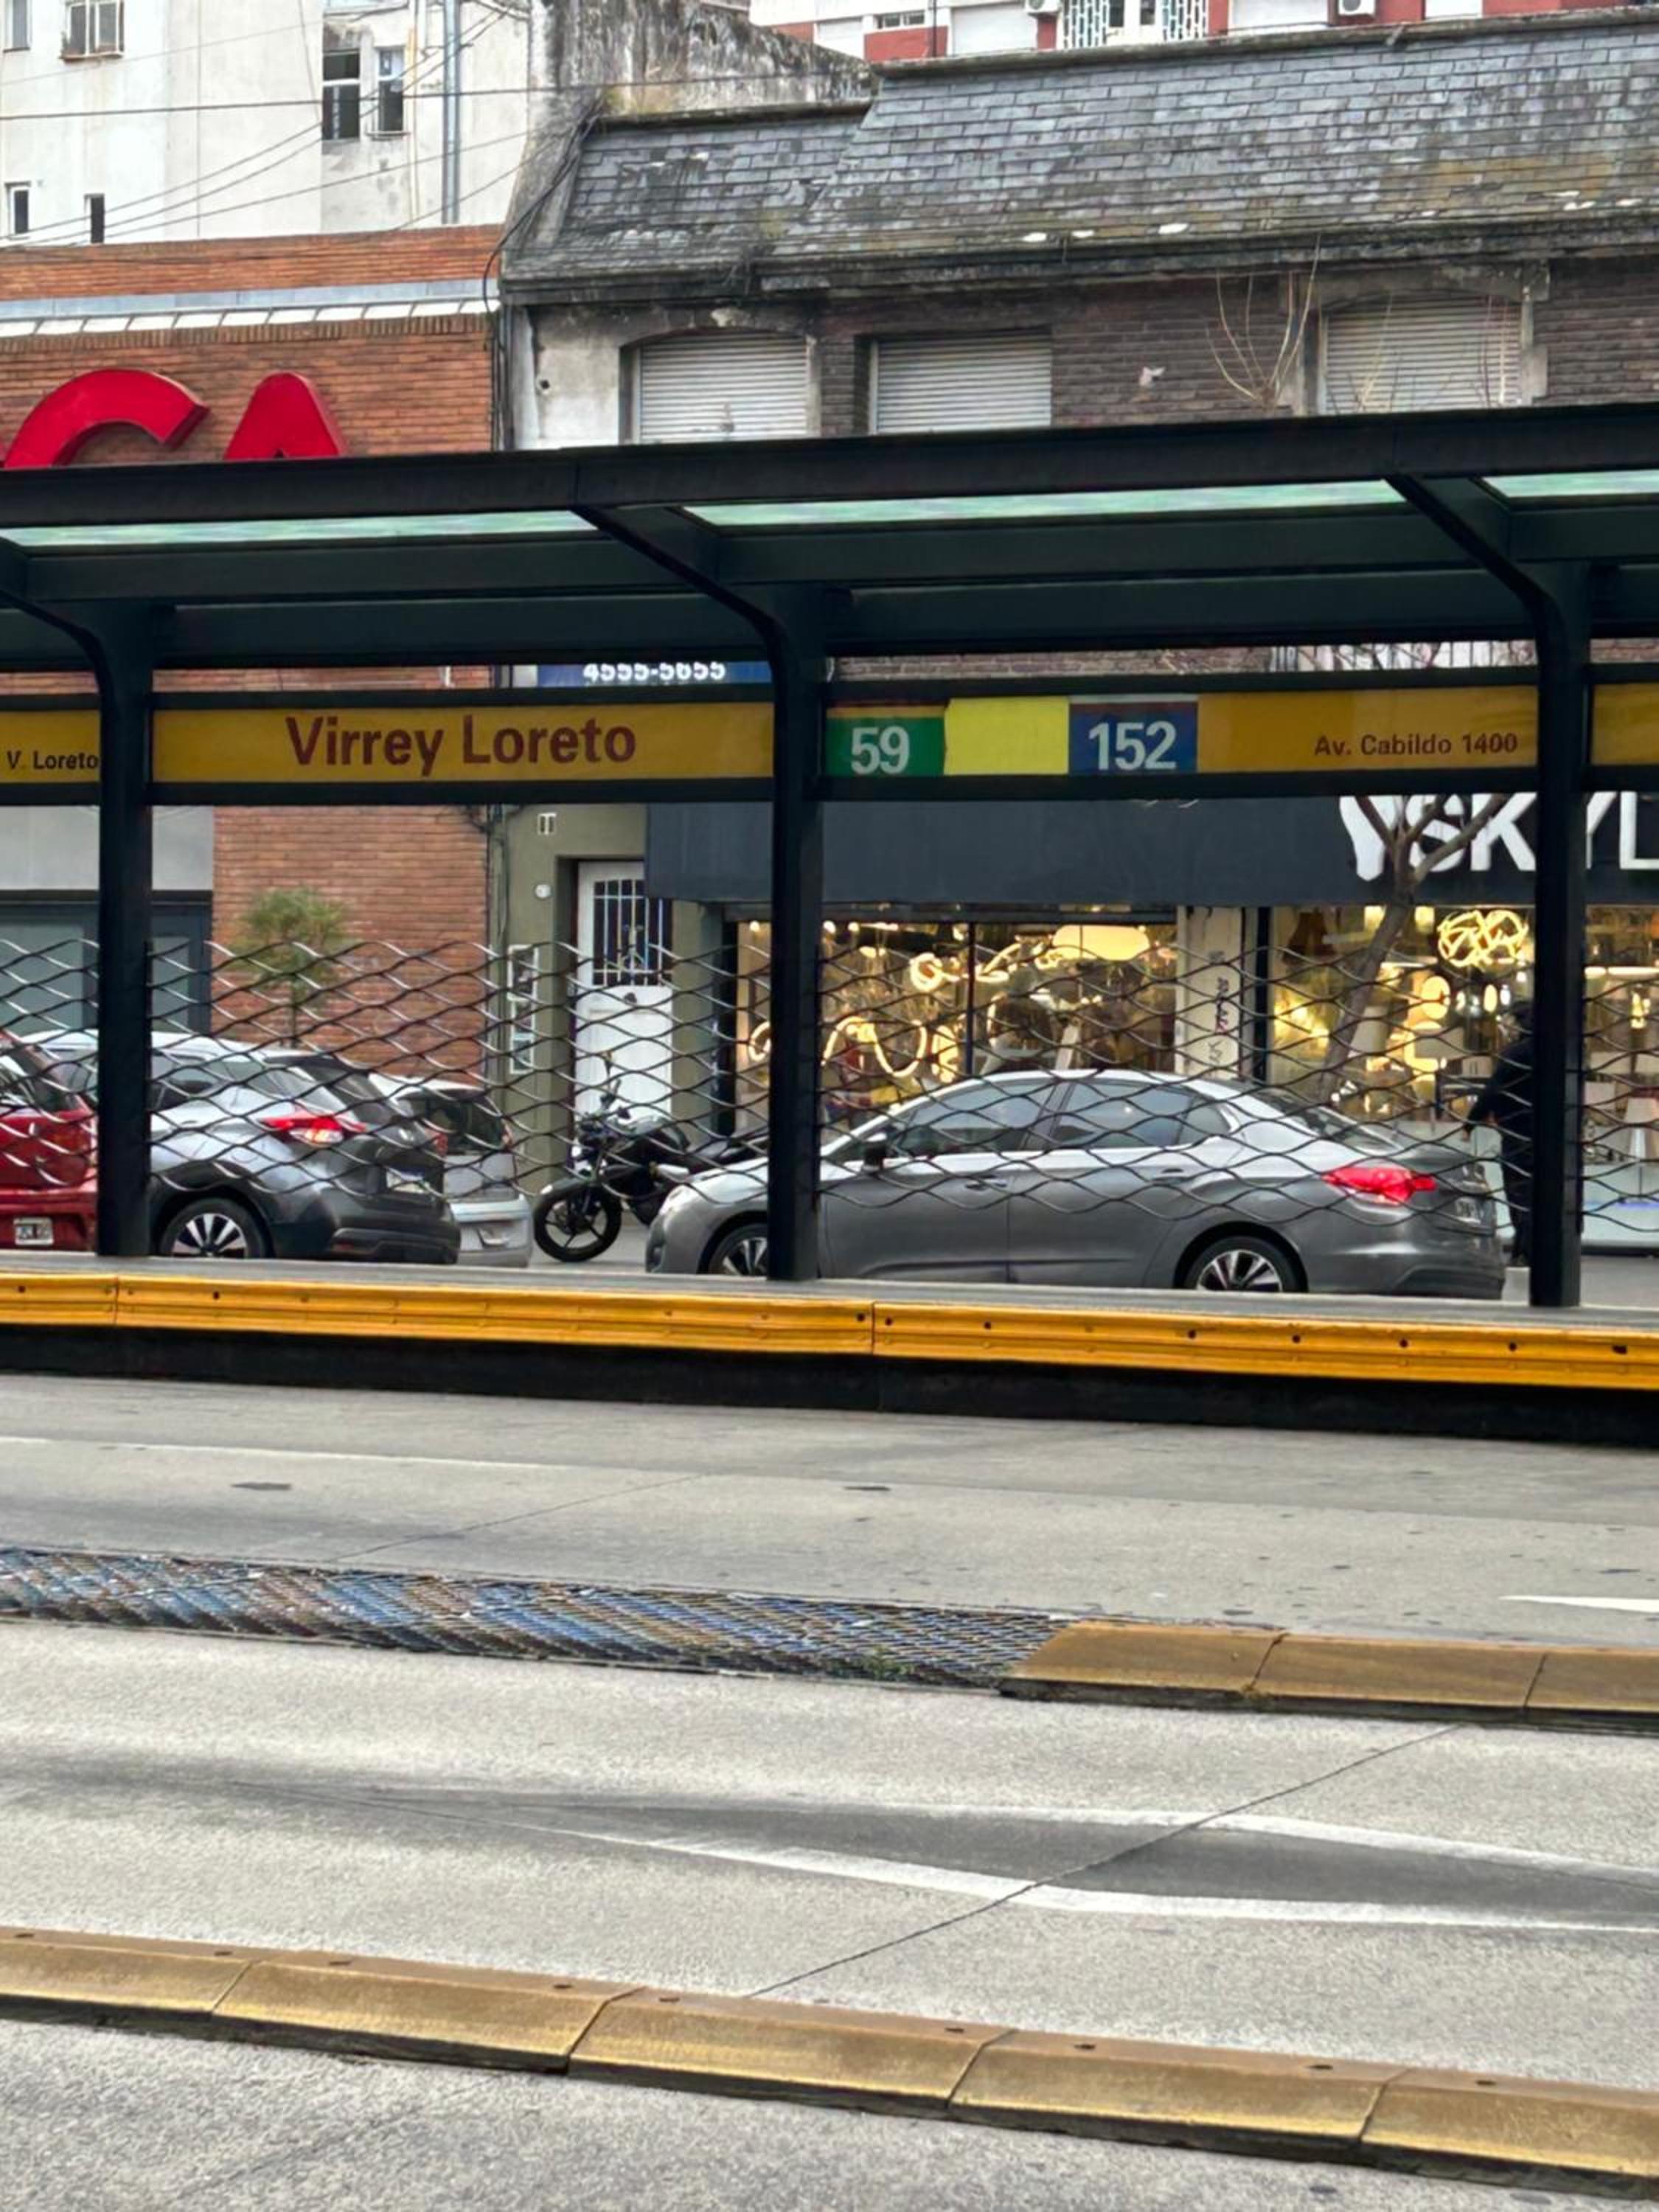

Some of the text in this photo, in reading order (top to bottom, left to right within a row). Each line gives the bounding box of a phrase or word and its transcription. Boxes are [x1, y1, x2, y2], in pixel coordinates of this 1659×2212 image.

[33, 750, 100, 770] Loreto
[285, 714, 636, 778] Virrey Loreto
[851, 726, 910, 775] 59
[1088, 720, 1178, 771] 152
[1314, 732, 1518, 756] Av. Cabildo 1400
